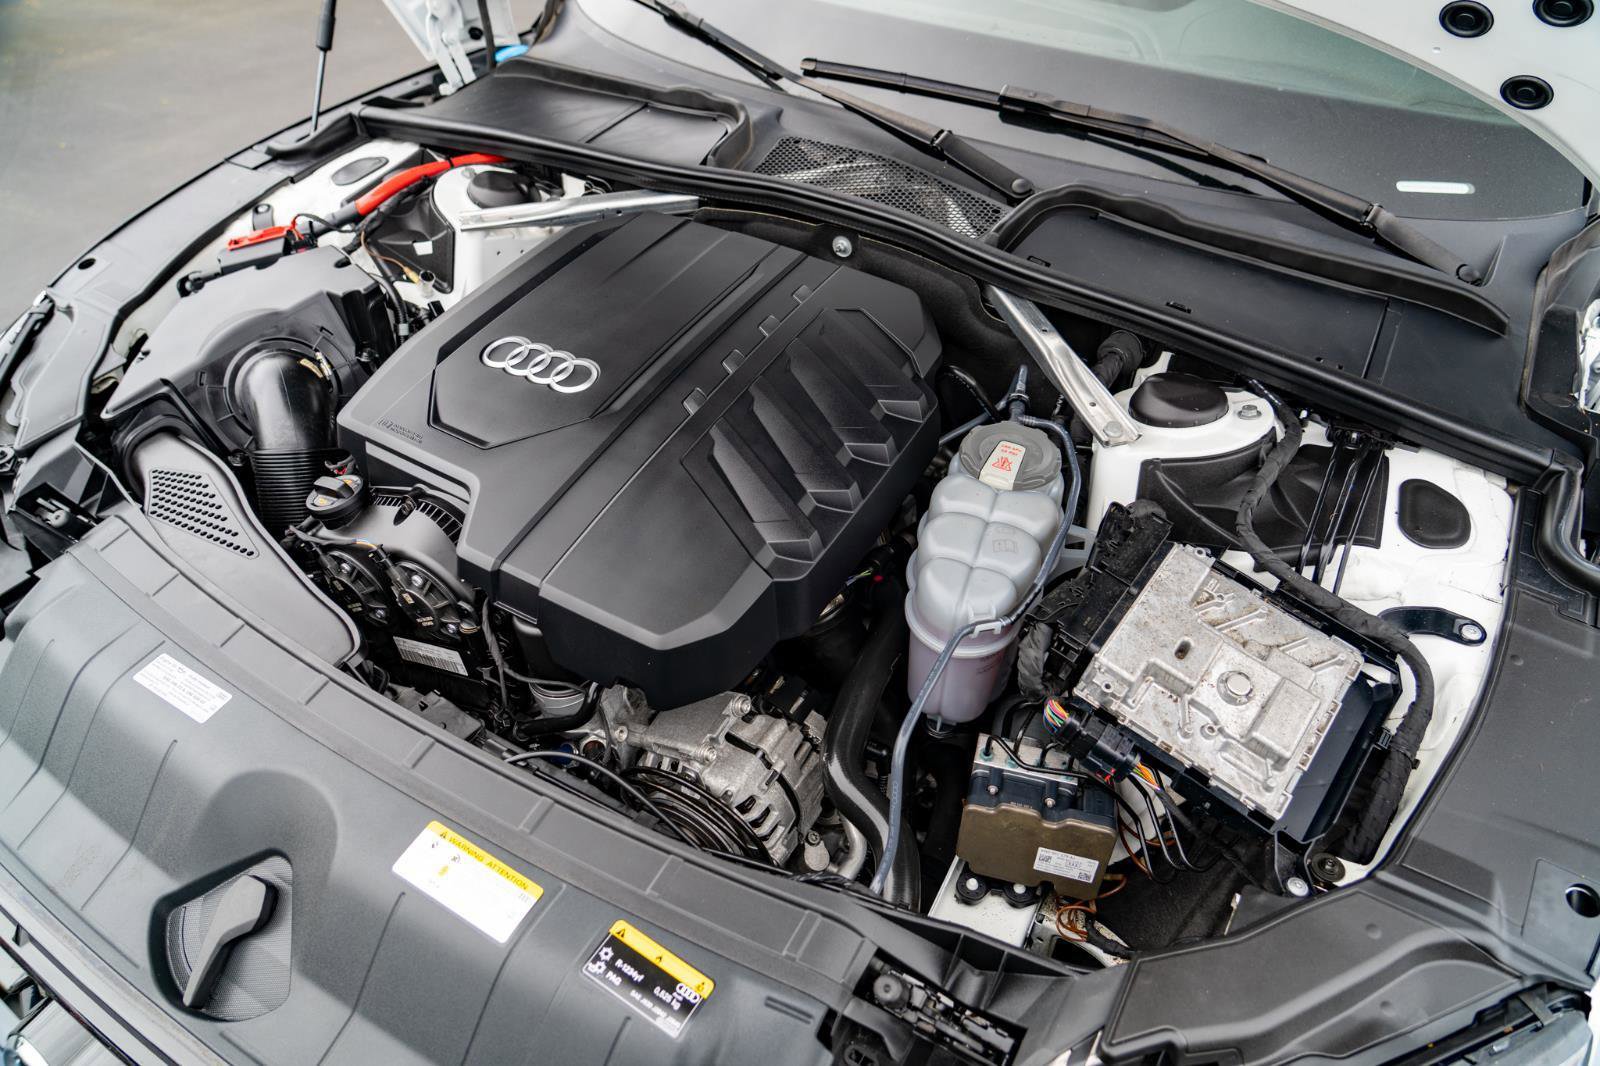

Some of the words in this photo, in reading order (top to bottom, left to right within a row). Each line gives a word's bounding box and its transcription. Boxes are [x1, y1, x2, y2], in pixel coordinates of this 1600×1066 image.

[449, 837, 484, 862] WARNING
[486, 861, 528, 891] ATTENTION
[605, 970, 622, 986] PAG
